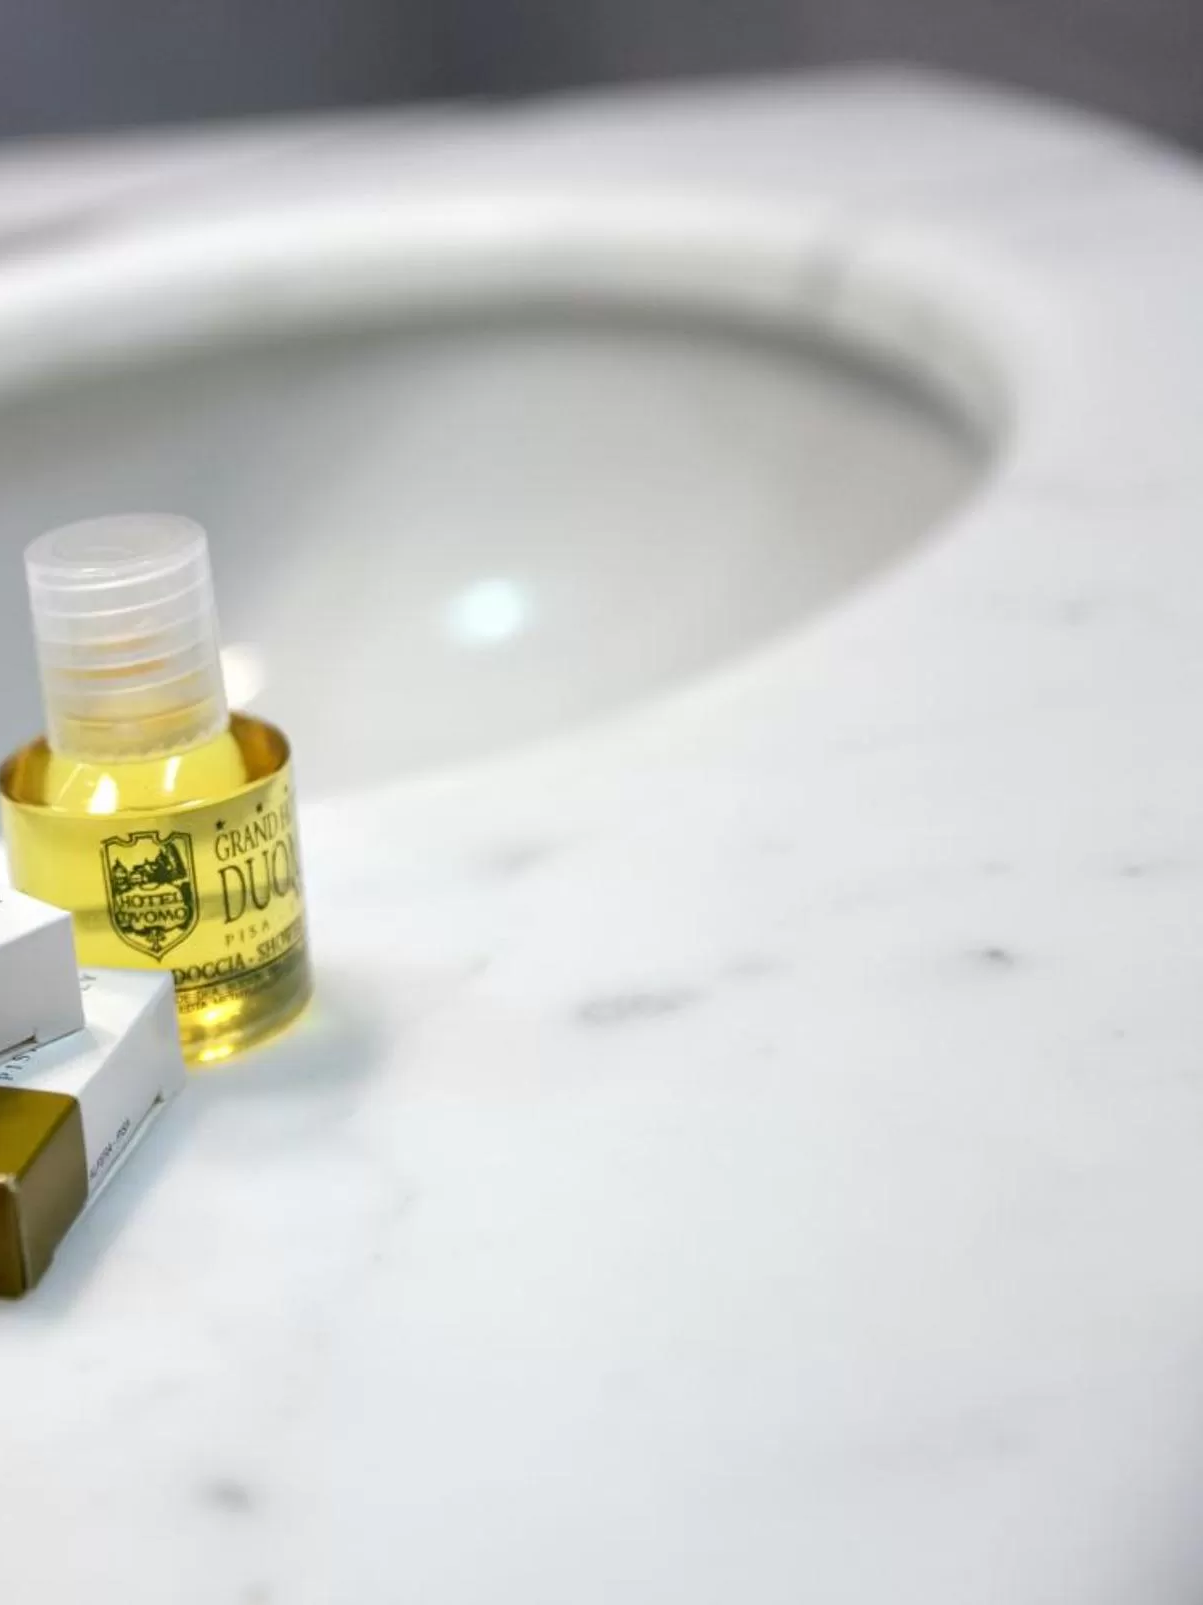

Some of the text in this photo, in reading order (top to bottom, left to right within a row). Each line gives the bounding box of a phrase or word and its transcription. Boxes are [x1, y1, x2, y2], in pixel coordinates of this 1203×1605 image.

[215, 810, 278, 861] GRAND
[224, 919, 270, 947] PISA
[172, 951, 245, 985] DOCCIA
